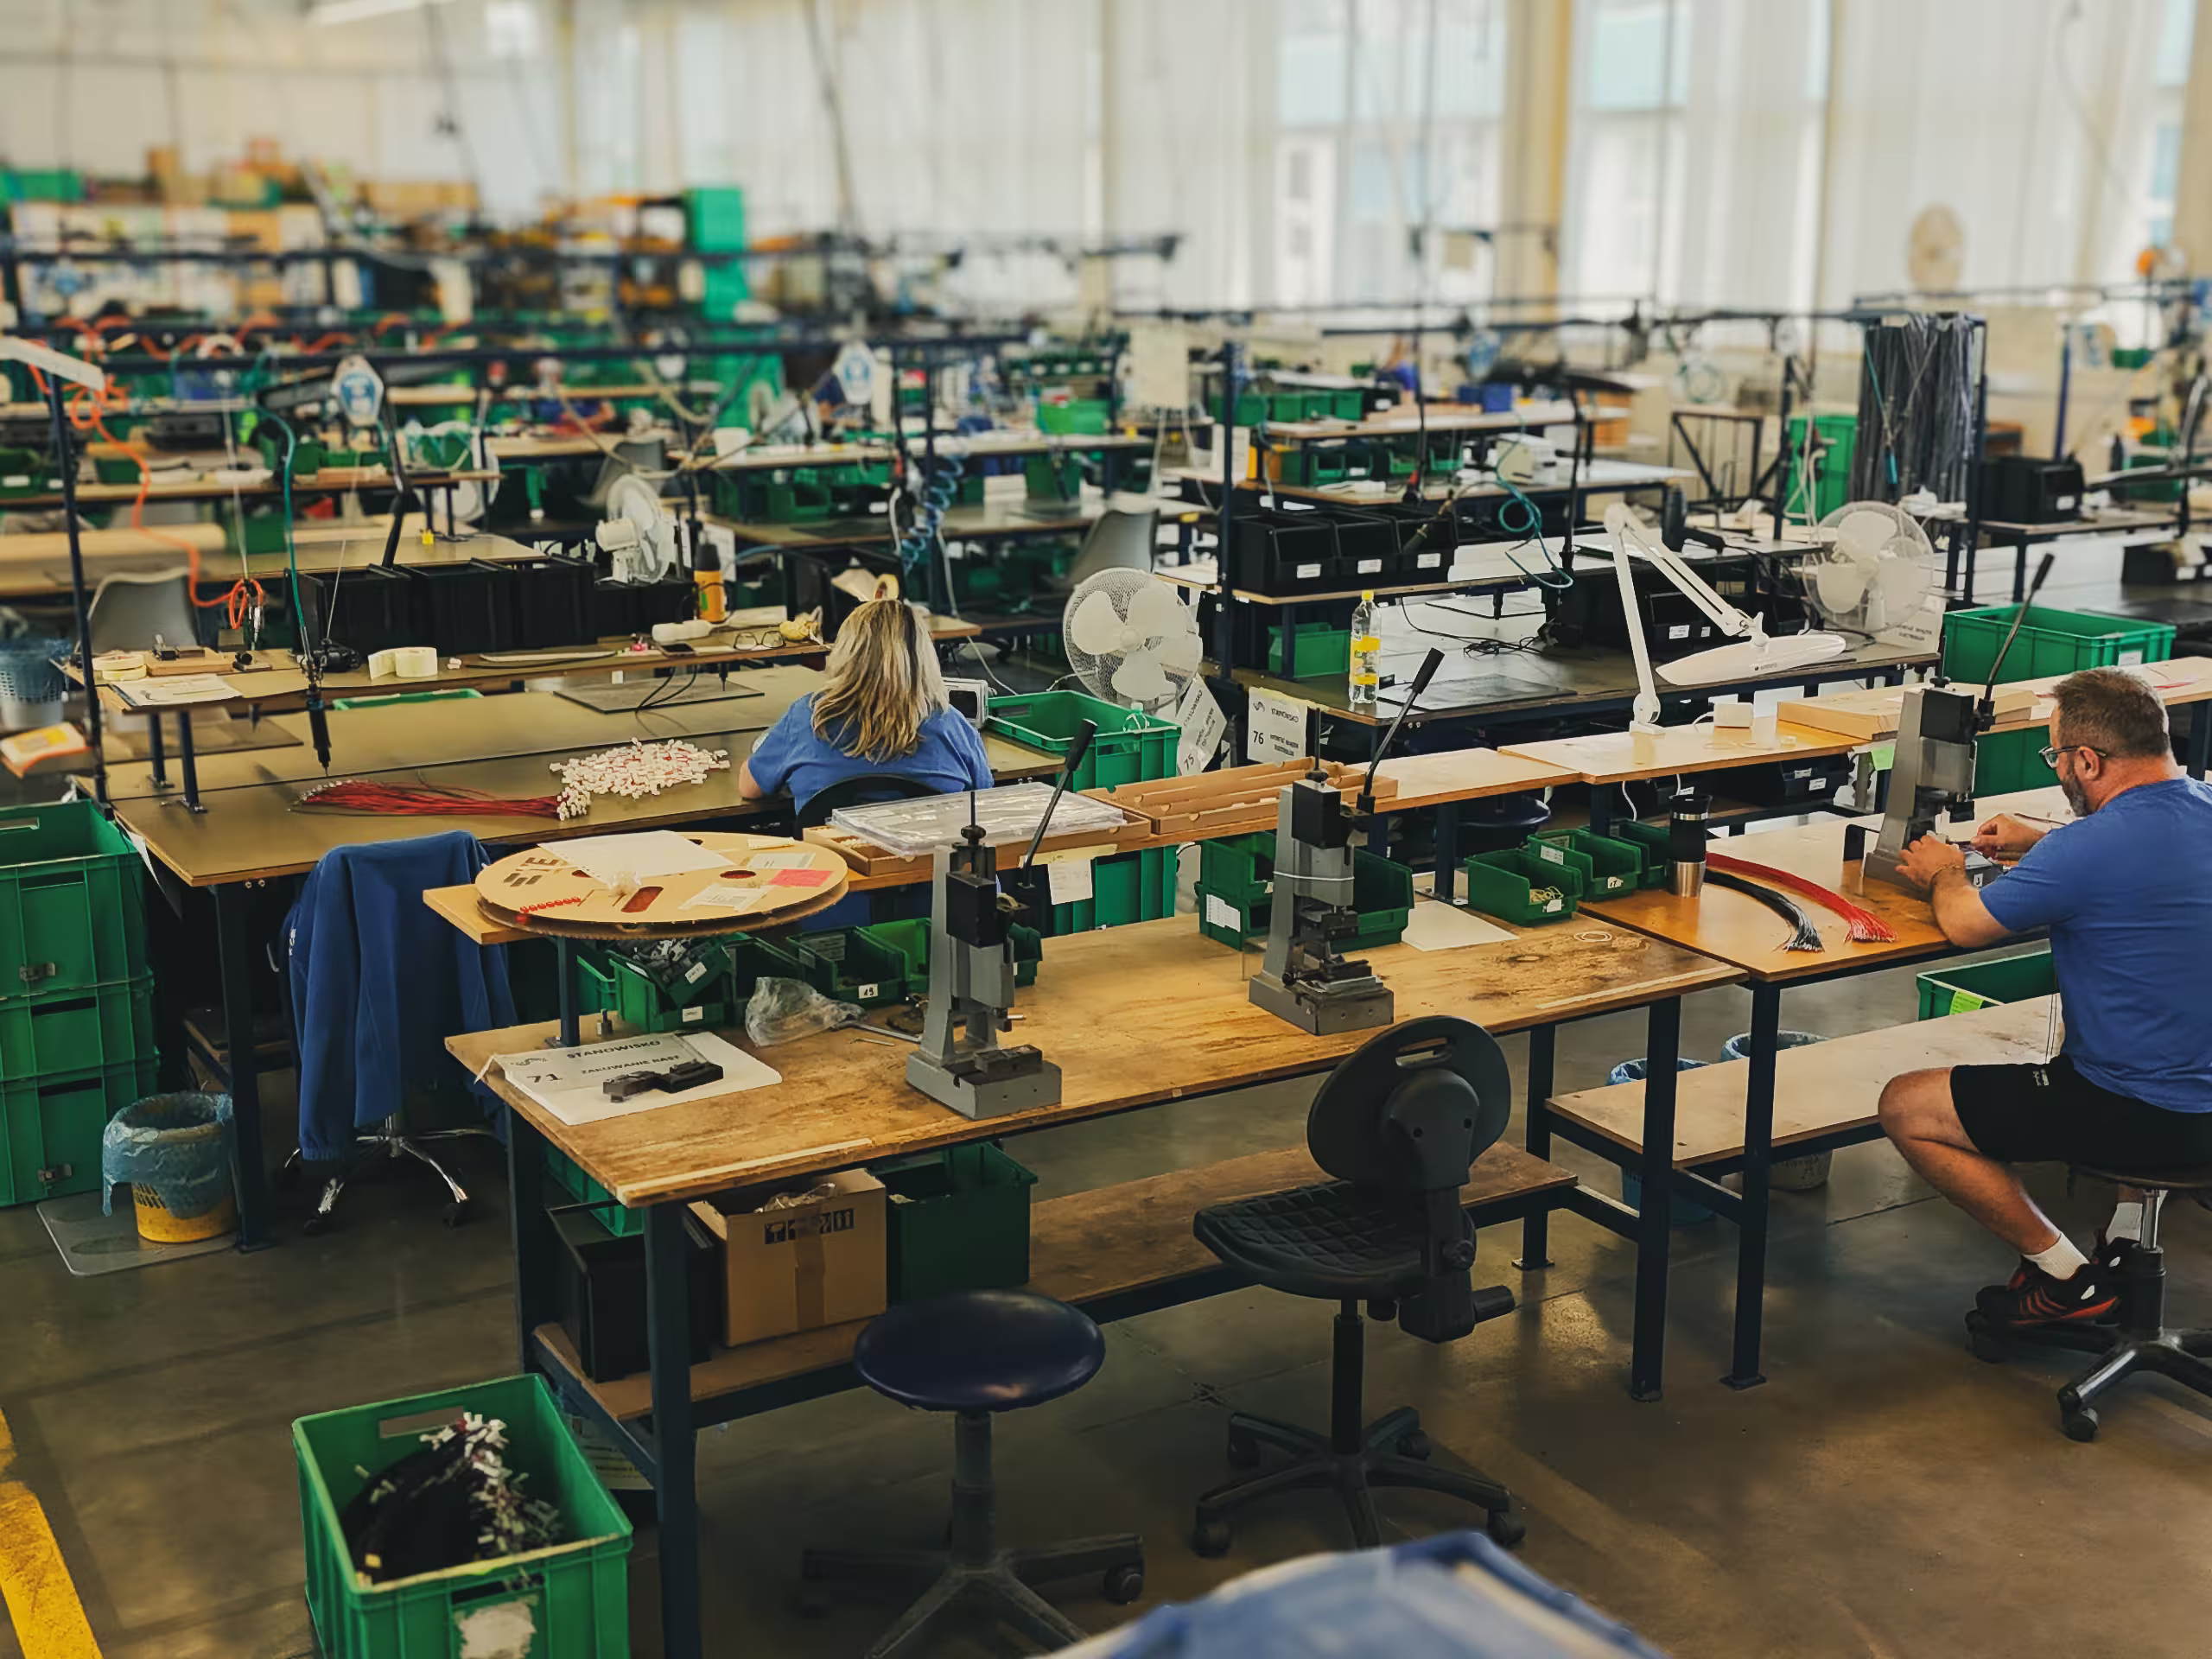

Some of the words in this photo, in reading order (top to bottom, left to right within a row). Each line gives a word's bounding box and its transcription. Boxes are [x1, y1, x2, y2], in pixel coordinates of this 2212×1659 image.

[1253, 730, 1264, 745] 76
[1183, 753, 1195, 771] 75
[567, 1039, 661, 1059] STANOWISKO
[526, 1072, 563, 1084] 71
